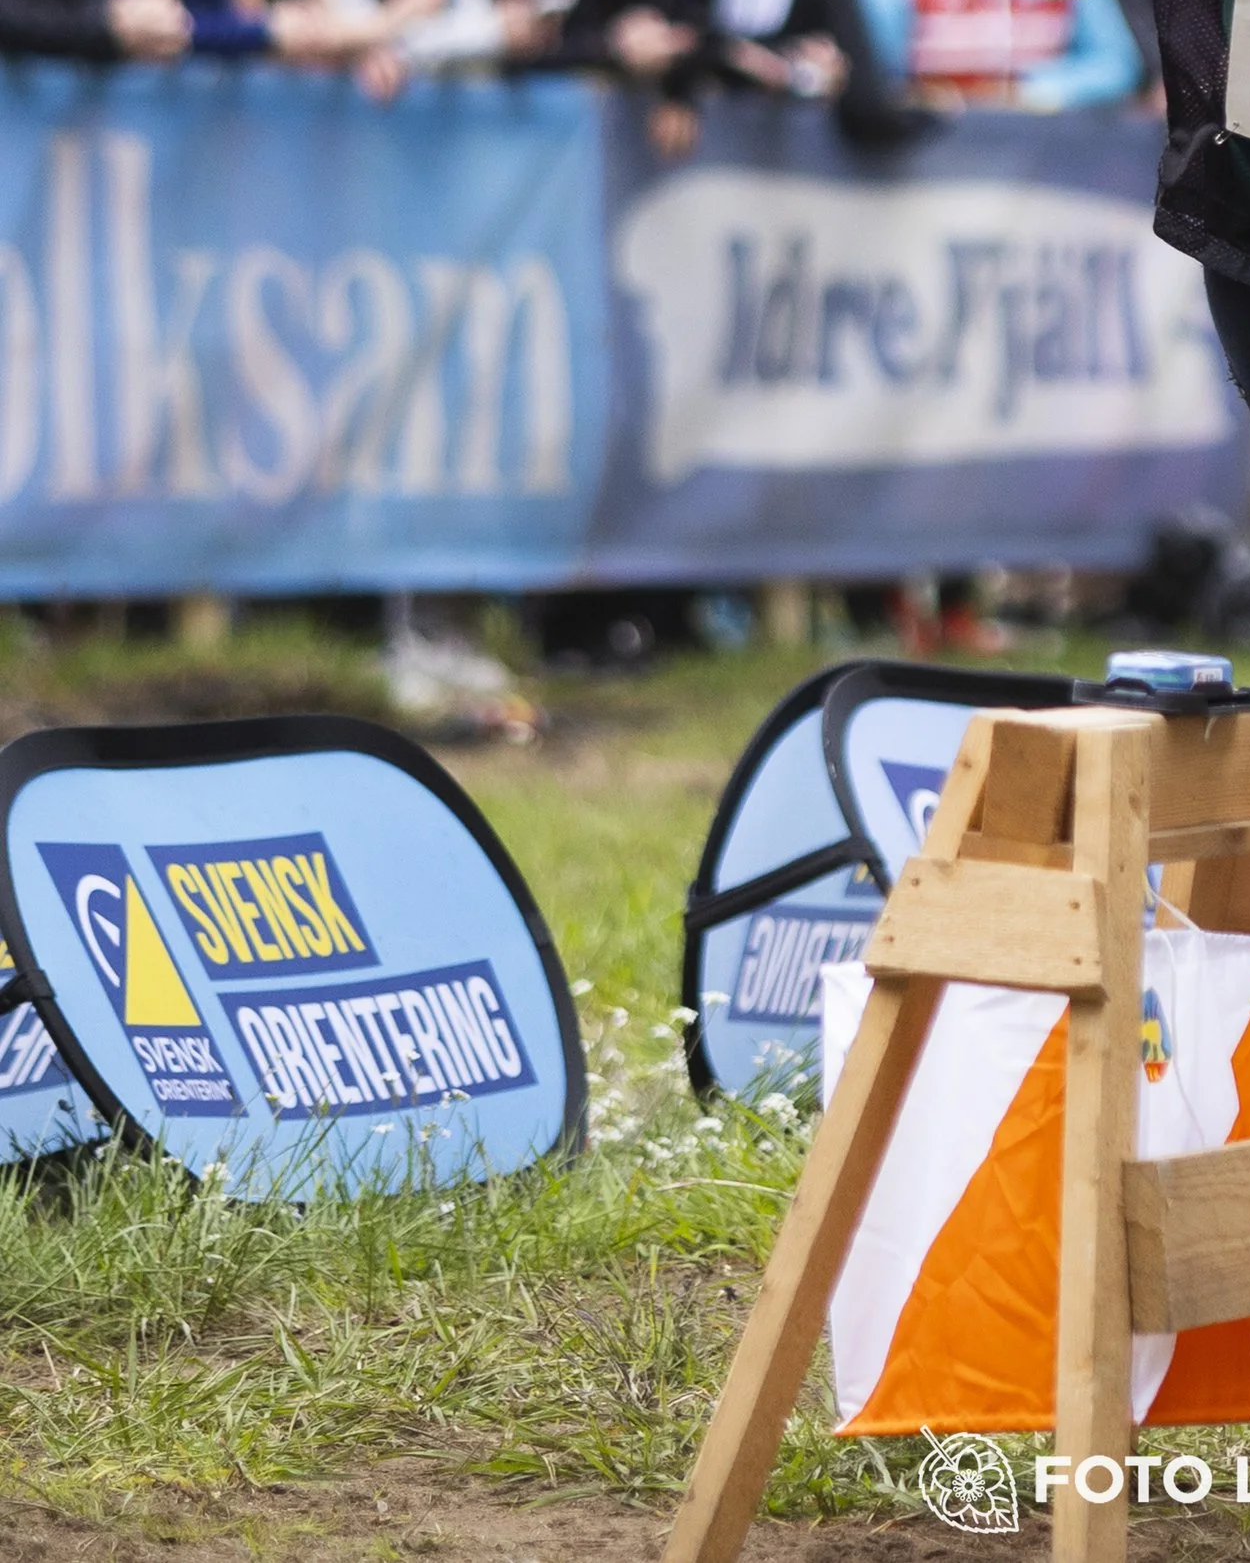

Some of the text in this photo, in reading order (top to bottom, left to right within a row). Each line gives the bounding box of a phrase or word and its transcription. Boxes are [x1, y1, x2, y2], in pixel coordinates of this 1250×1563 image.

[166, 852, 366, 965] SVENSK
[132, 1036, 223, 1074] SVENSK
[237, 975, 523, 1109] ORIENTERING
